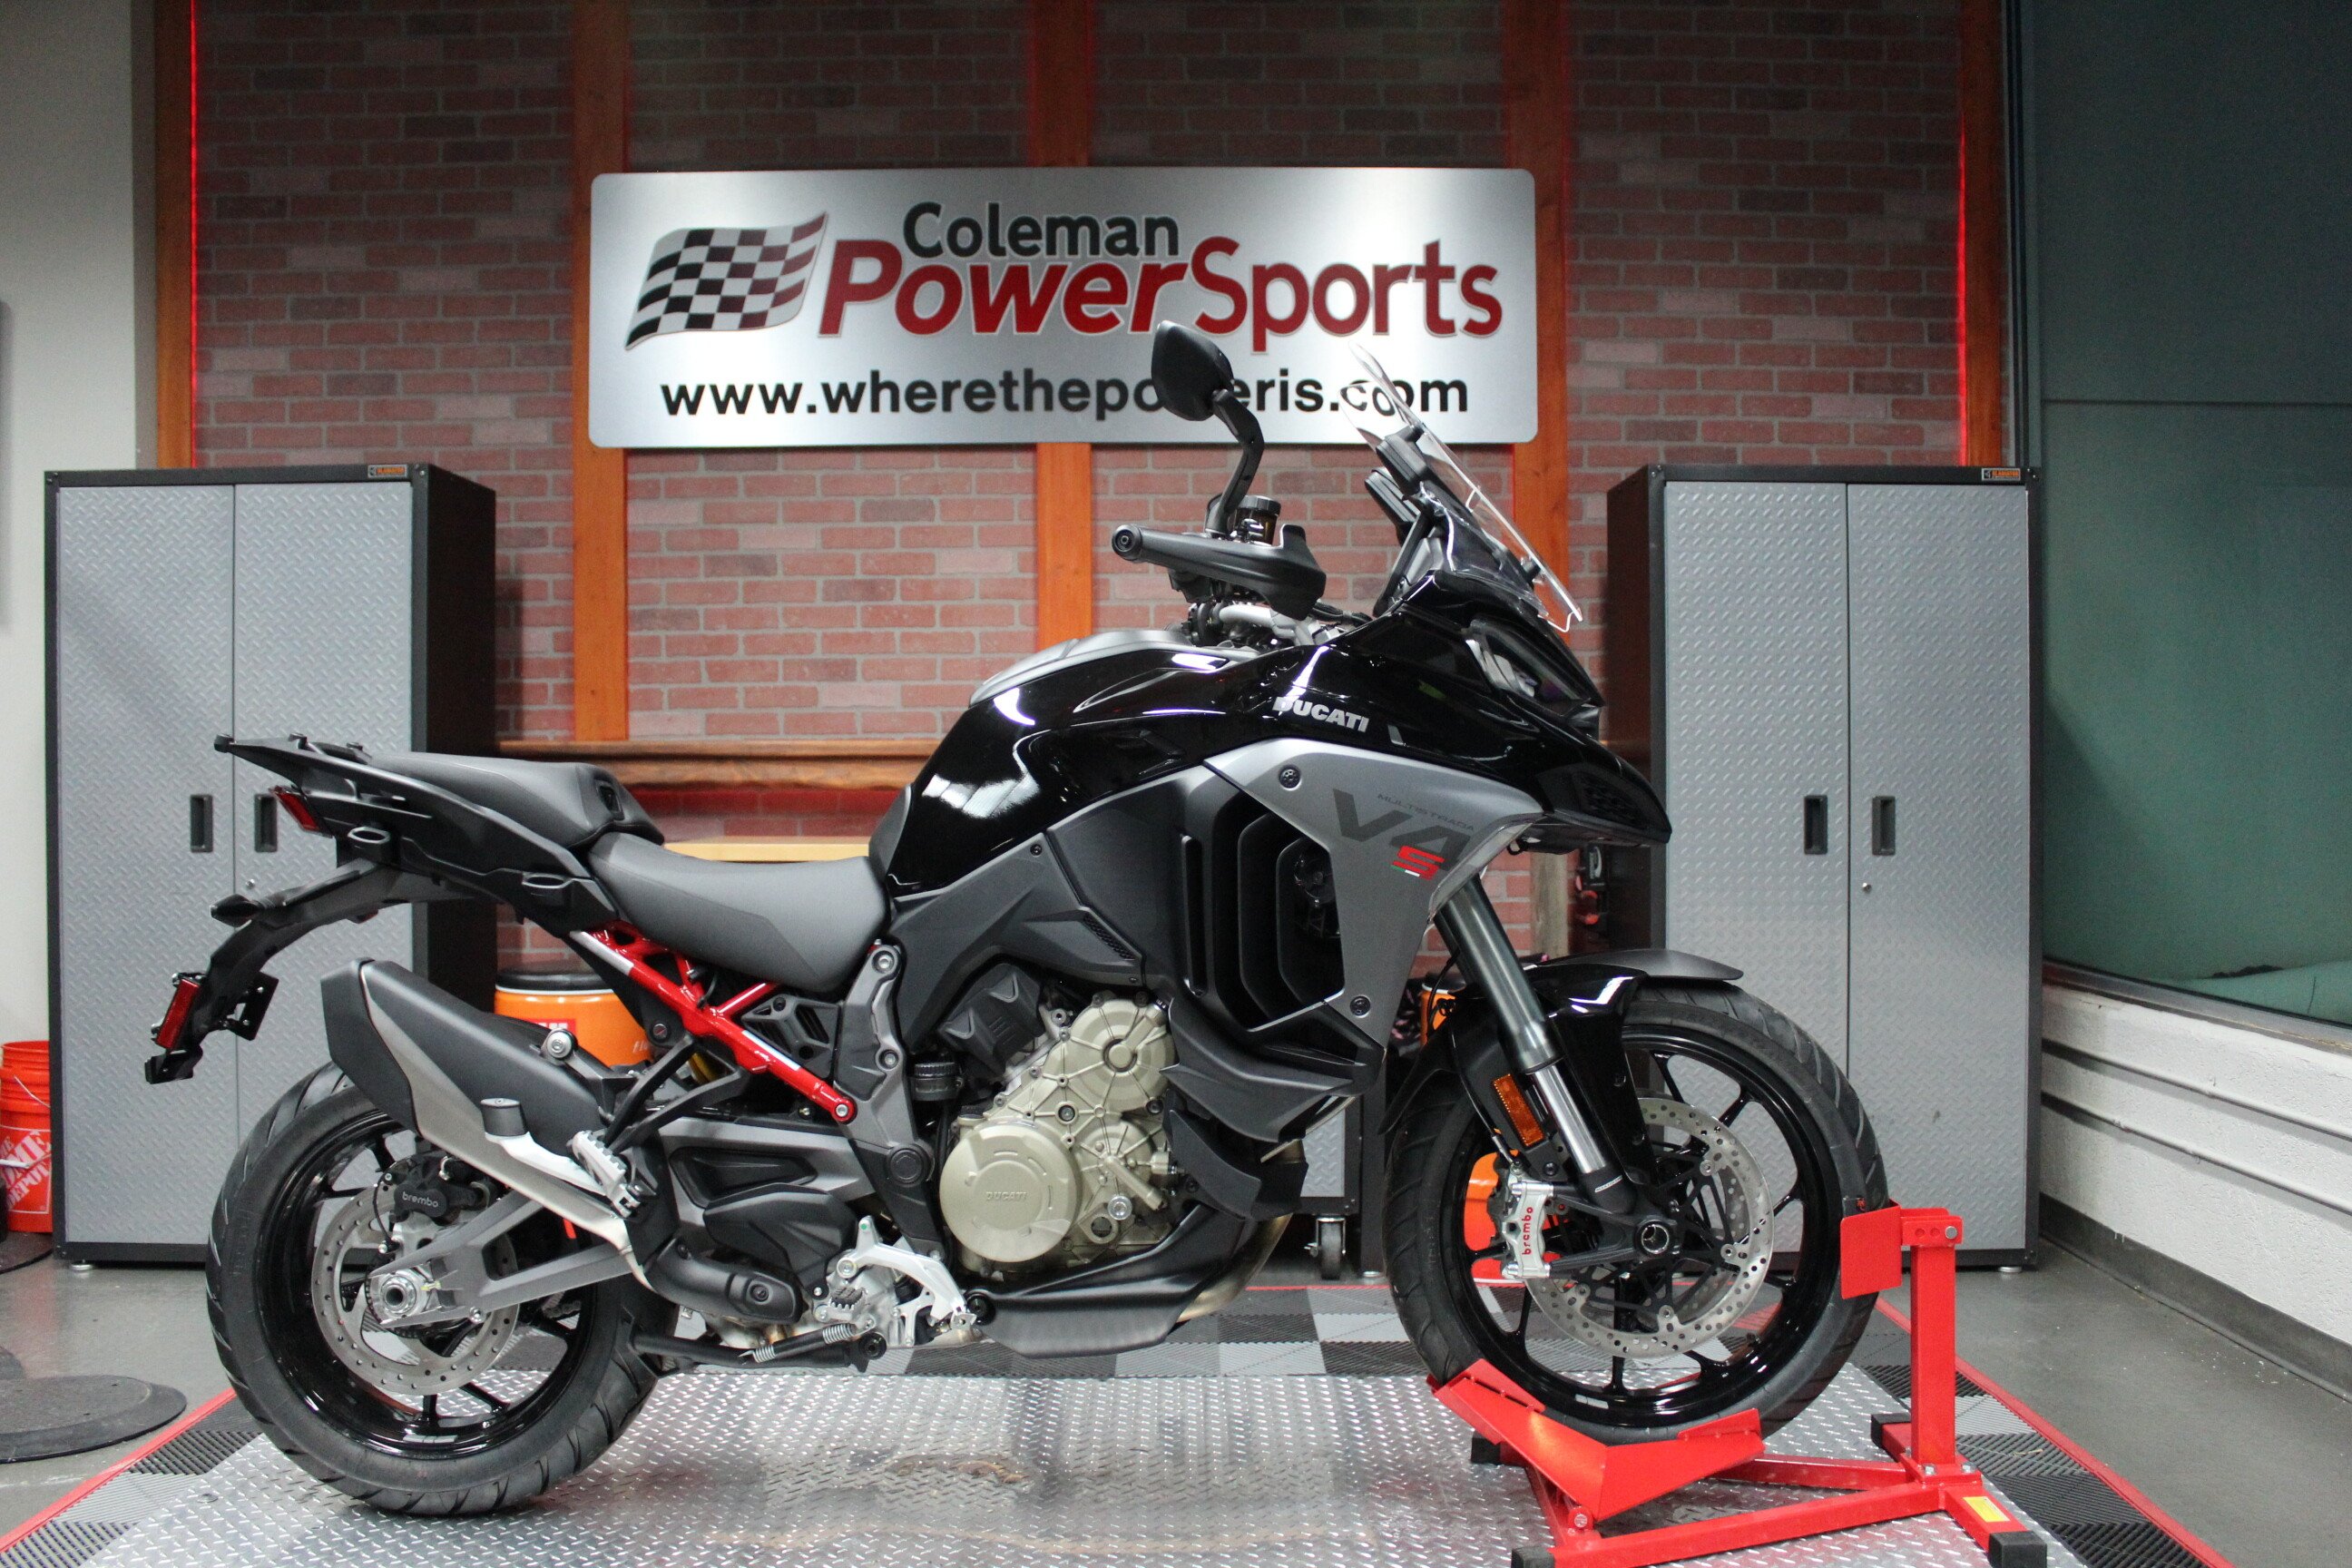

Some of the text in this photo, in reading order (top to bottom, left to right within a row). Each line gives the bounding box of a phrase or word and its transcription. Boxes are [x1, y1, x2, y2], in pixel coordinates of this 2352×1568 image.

[903, 201, 1180, 259] Coleman
[818, 235, 1503, 353] PowerSports
[661, 368, 1468, 421] www.wherethepoeris.com
[1272, 697, 1369, 732] DUCATI
[402, 1191, 439, 1208] brembo
[985, 1191, 1027, 1202] DUCATI
[1521, 1207, 1534, 1255] brembo
